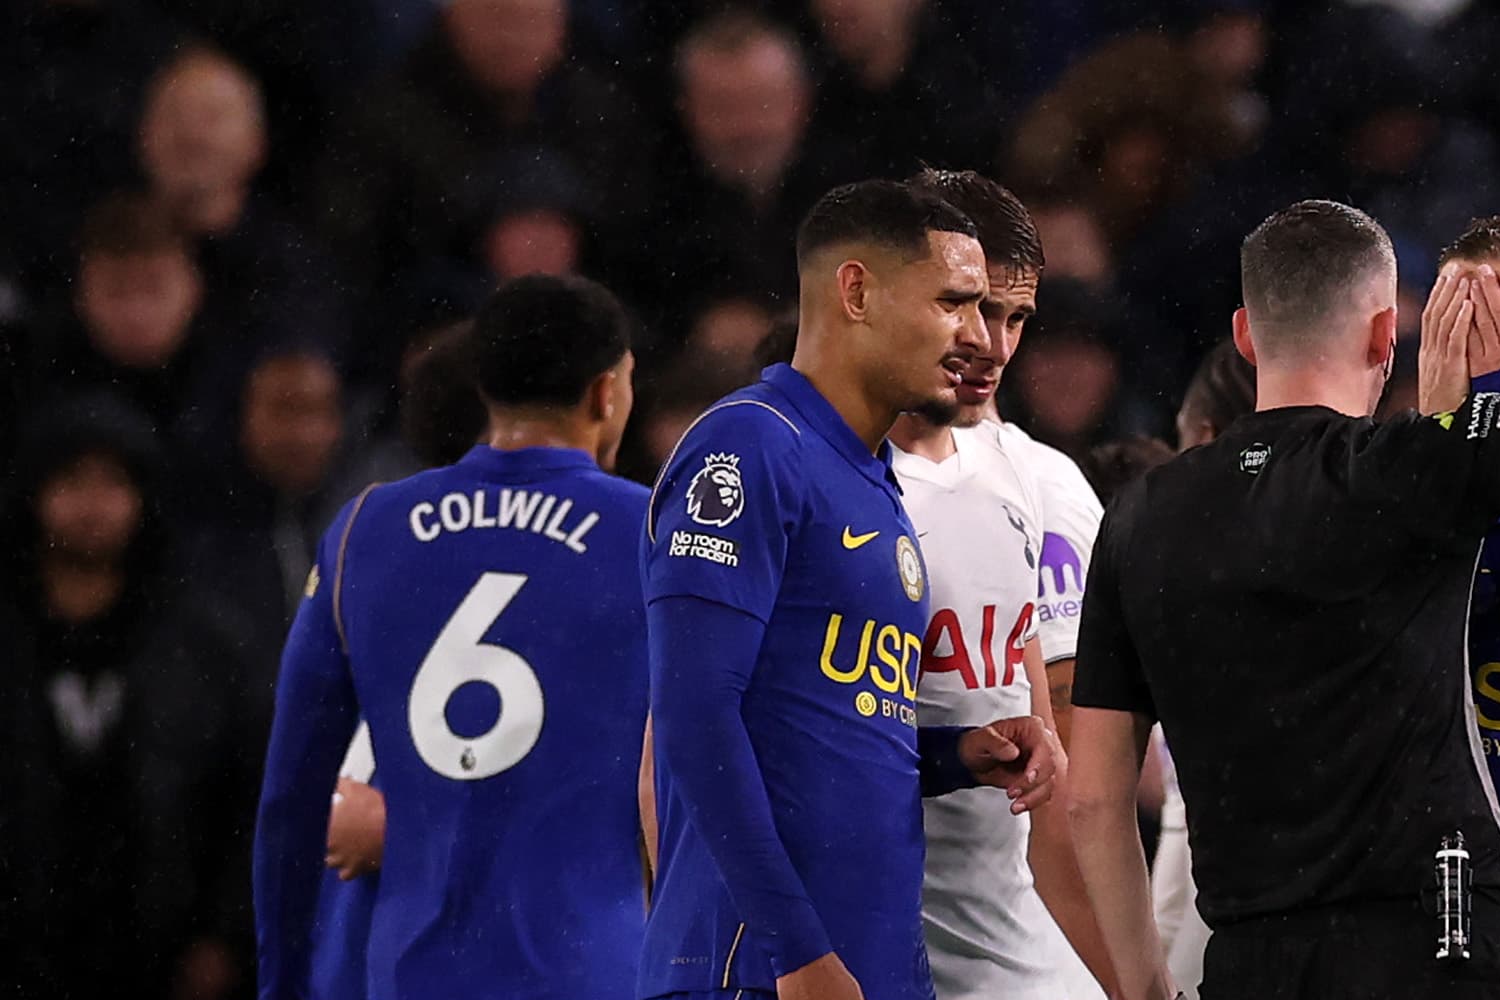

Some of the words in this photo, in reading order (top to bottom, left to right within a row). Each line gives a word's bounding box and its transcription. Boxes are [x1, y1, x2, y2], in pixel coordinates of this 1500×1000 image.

[1246, 450, 1268, 460] PRO
[409, 489, 600, 553] COLWILL
[671, 530, 692, 545] No
[693, 534, 734, 554] room
[690, 545, 738, 567] racism
[1037, 600, 1082, 622] ake
[820, 613, 921, 701] USD
[408, 571, 545, 781] 6
[882, 698, 898, 719] BY
